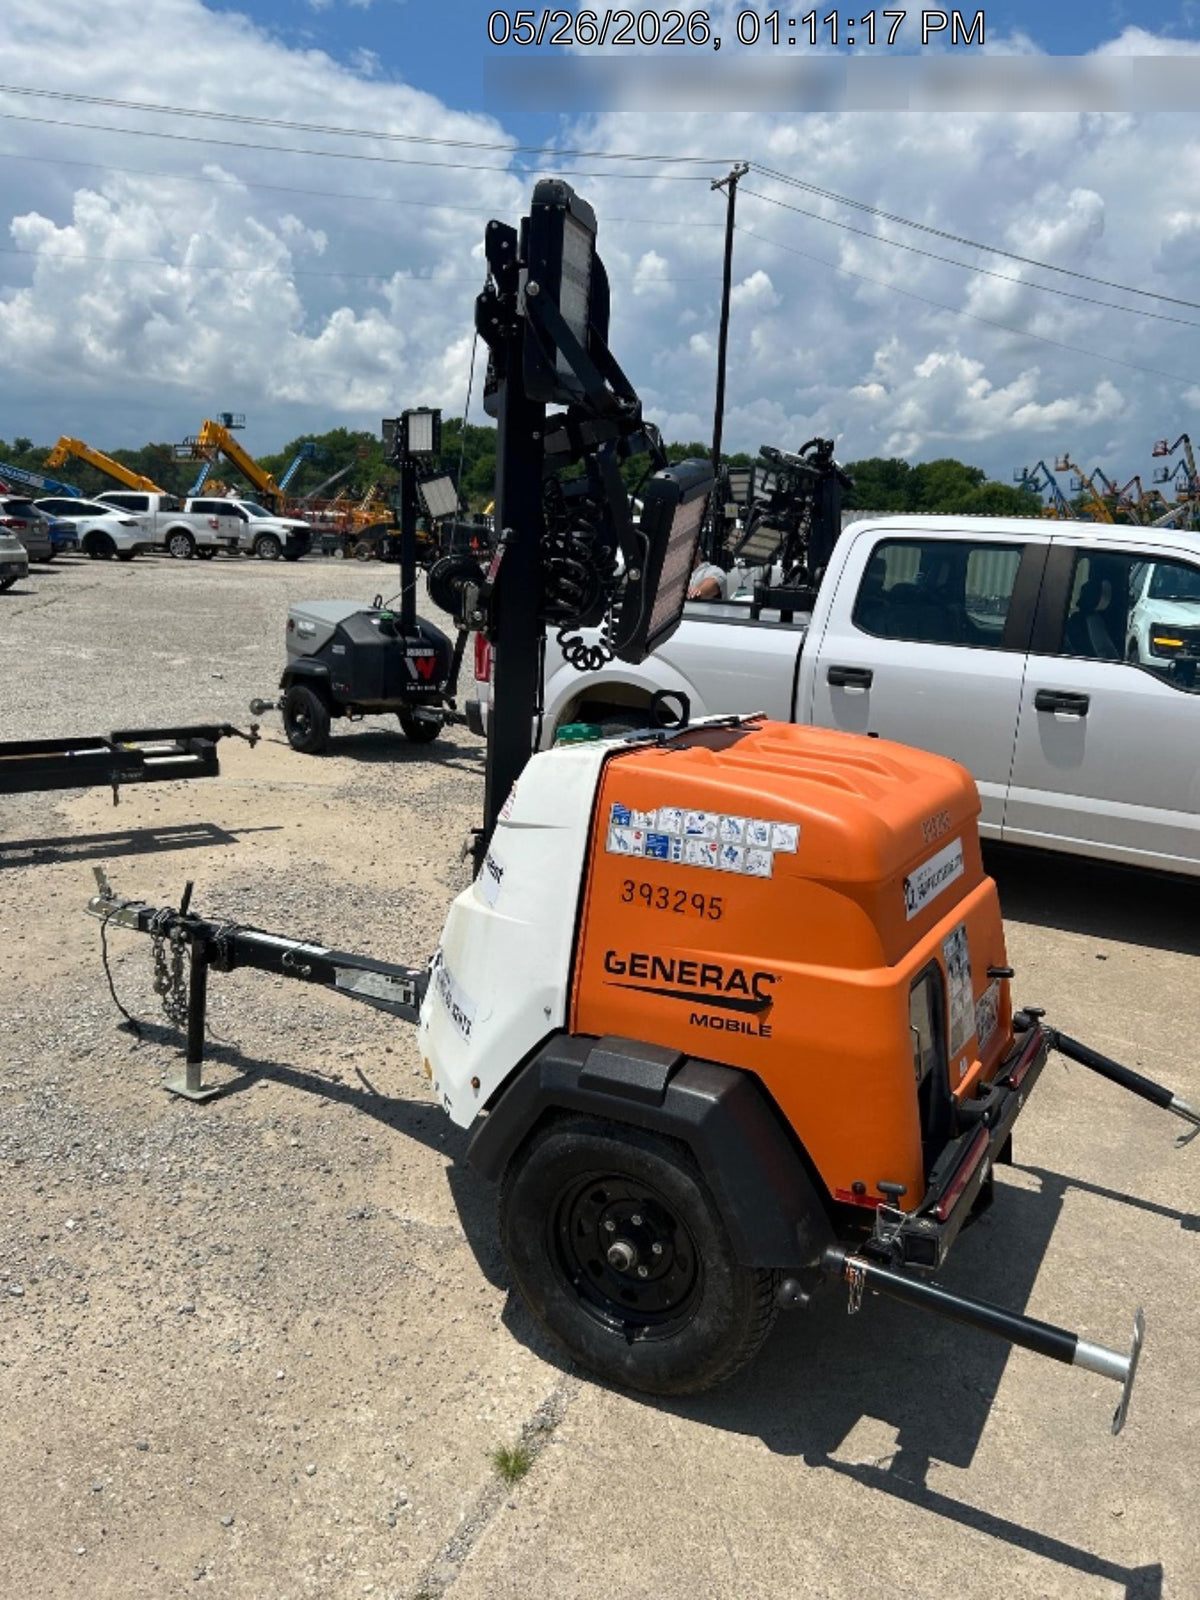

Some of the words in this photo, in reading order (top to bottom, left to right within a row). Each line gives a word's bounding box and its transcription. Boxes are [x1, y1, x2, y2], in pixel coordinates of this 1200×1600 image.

[620, 879, 723, 920] 393295
[603, 949, 776, 1002] GENERAC
[689, 1012, 773, 1038] MOBILE
